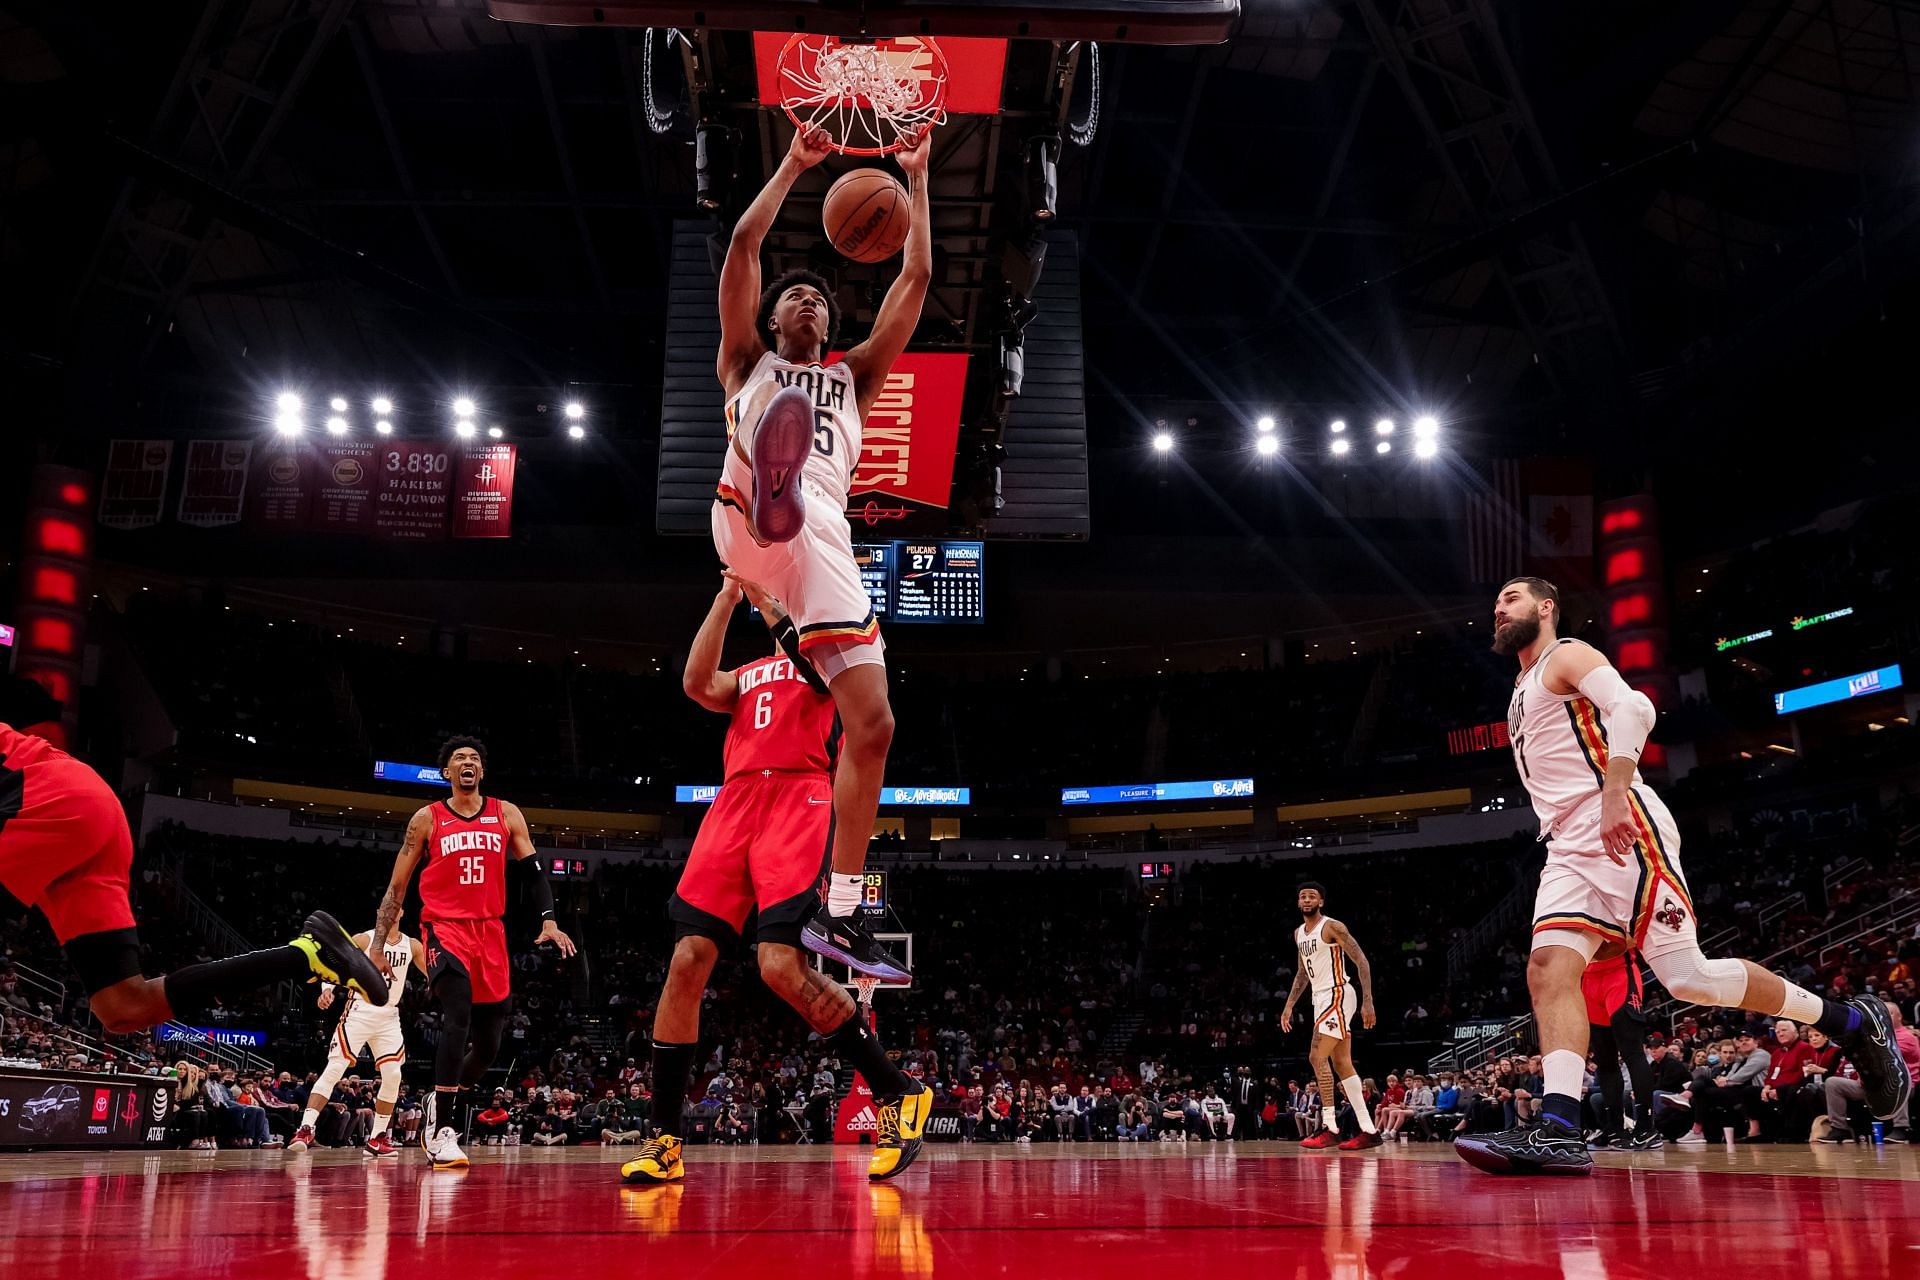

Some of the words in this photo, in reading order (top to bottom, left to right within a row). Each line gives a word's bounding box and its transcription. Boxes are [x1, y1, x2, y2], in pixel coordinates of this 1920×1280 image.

[840, 206, 888, 253] Wilson
[386, 451, 448, 475] 3,830
[389, 479, 442, 490] HAKEEM
[380, 492, 446, 505] OLAJUWON
[906, 545, 937, 555] PELICANS
[912, 554, 934, 570] 27
[1793, 607, 1854, 630] DRAFTKINGS
[1717, 629, 1773, 651] DRAFTKINGS
[739, 658, 808, 695] OCKET
[754, 691, 773, 730] 6
[1515, 734, 1530, 779] 7
[1120, 789, 1149, 798] PLEASURE
[440, 831, 502, 857] ROCKETS
[459, 855, 485, 885] 35
[385, 950, 407, 968] OLA
[1306, 958, 1315, 978] 6
[216, 1033, 257, 1047] ULTRA
[1454, 1026, 1478, 1039] LIGHT
[87, 1125, 108, 1134] TOYOTA
[846, 1120, 877, 1131] adida
[925, 1117, 960, 1134] LIGH
[146, 1127, 166, 1142] AT&T
